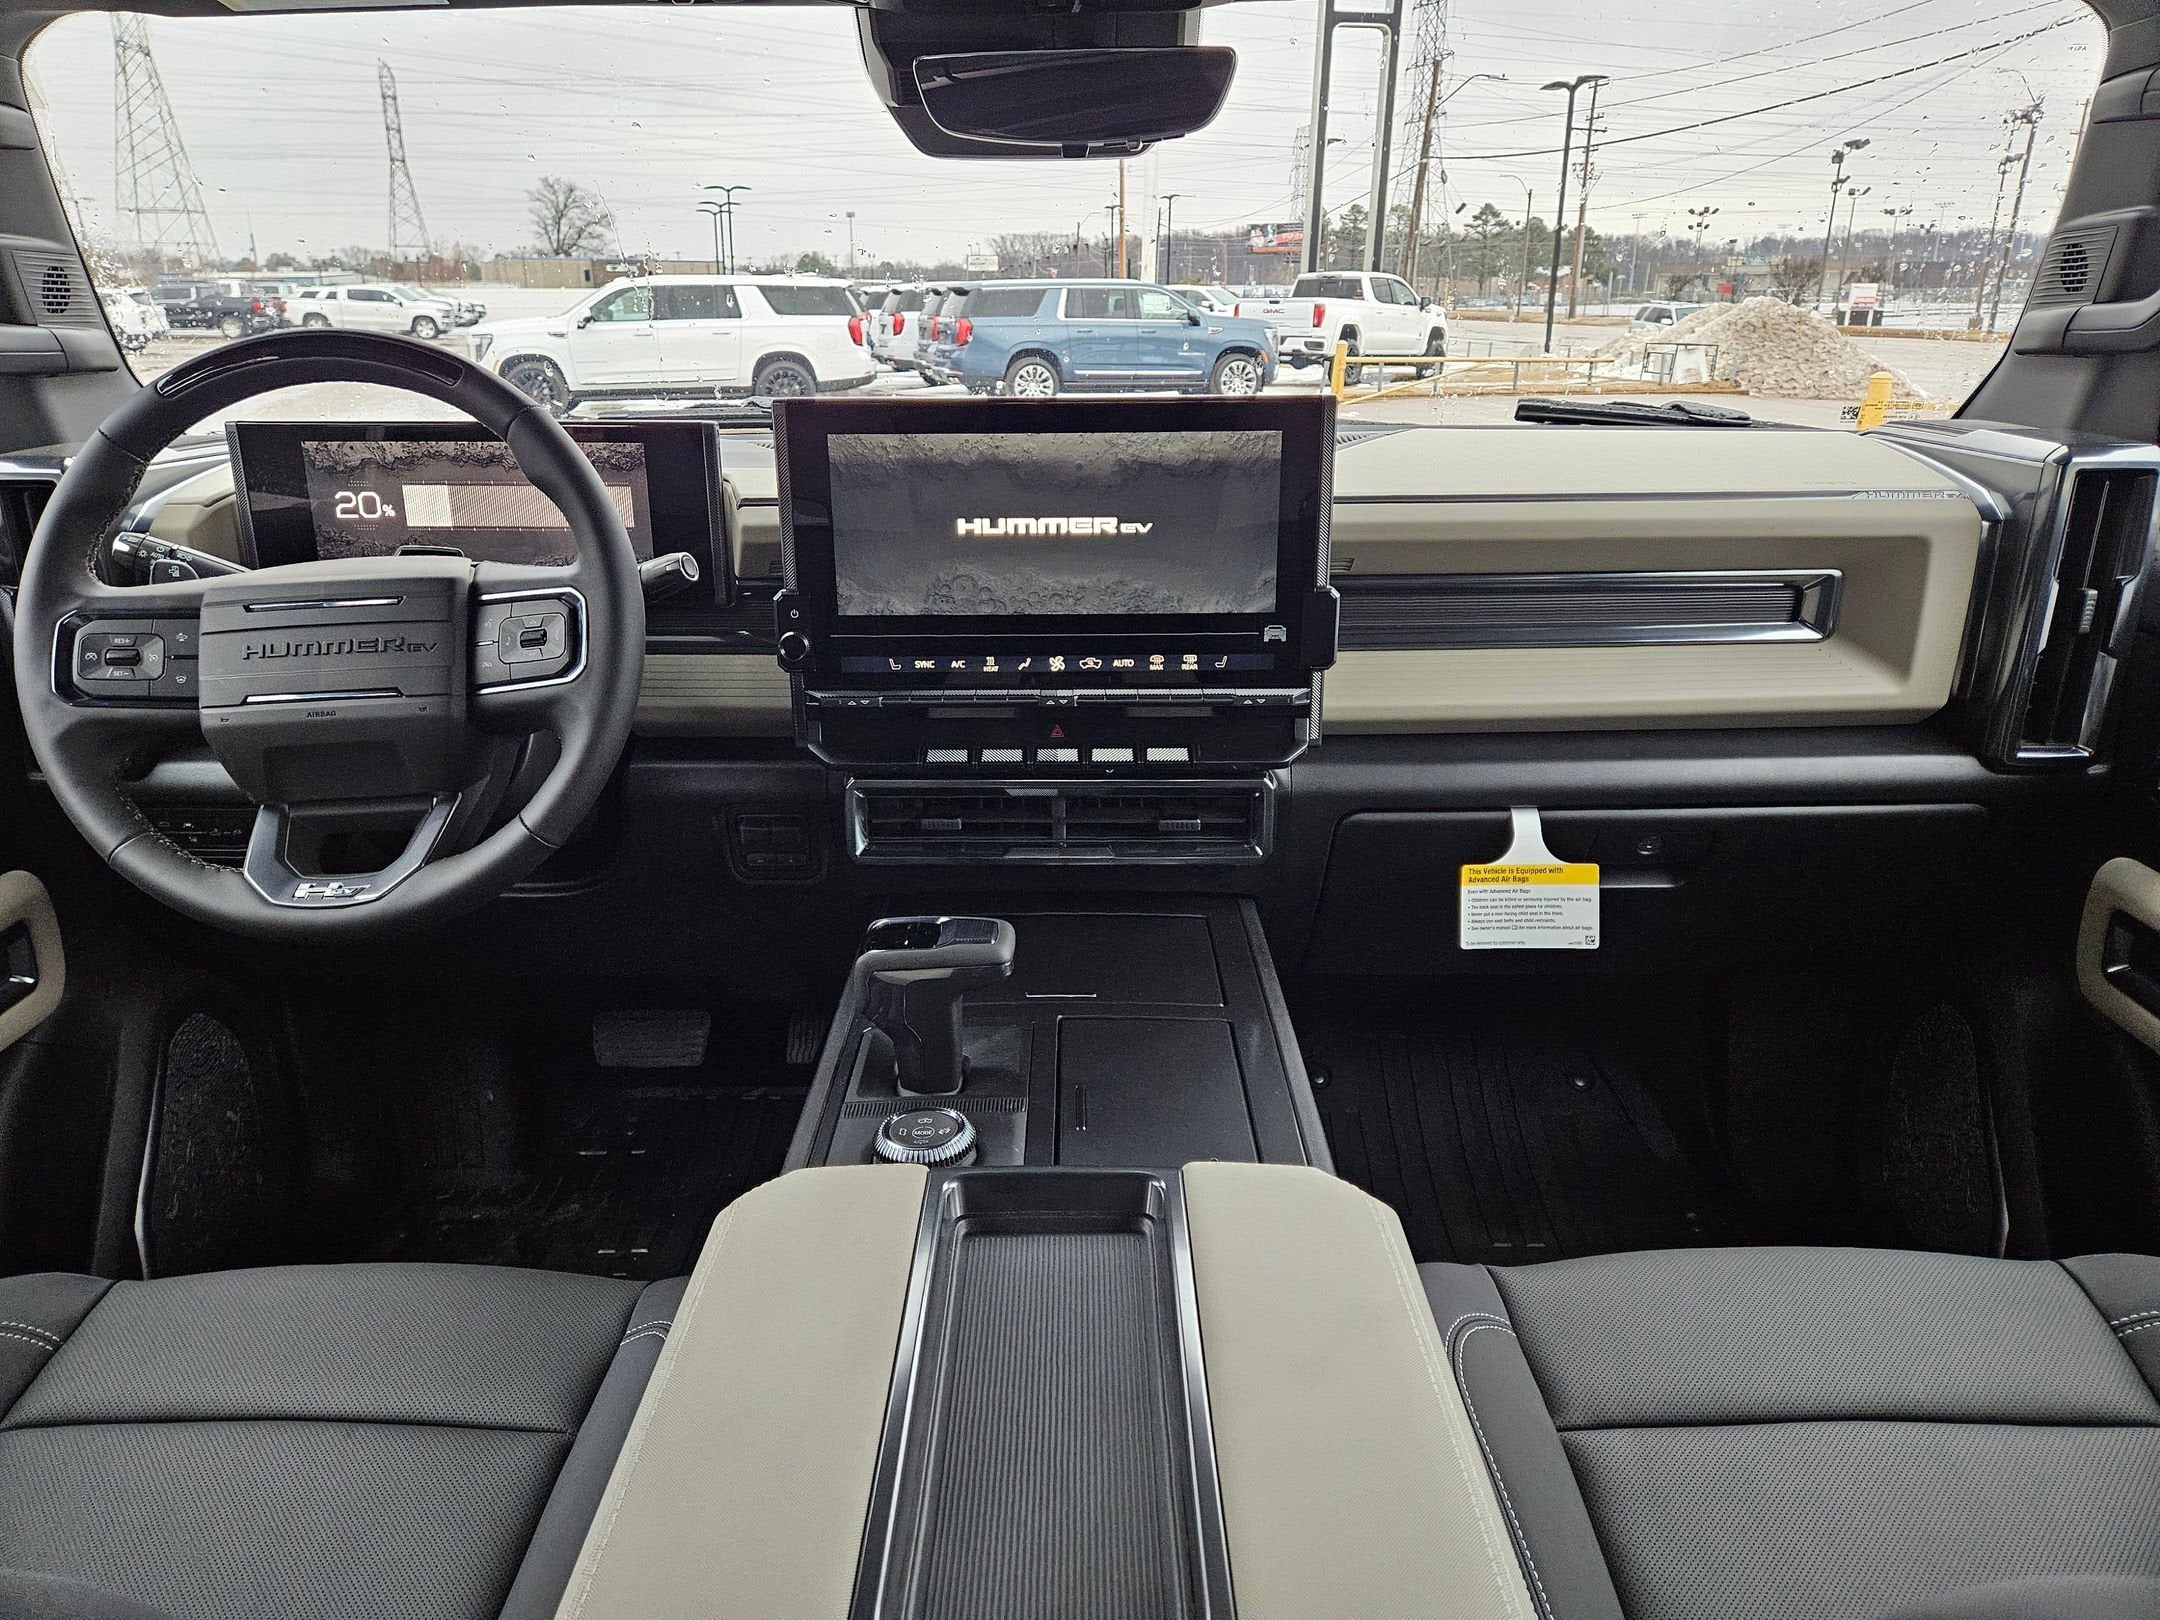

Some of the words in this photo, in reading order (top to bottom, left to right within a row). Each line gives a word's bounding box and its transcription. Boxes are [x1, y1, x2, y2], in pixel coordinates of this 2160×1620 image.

[1865, 490, 1945, 499] HUMMER
[956, 517, 1118, 535] HUMMER
[1120, 522, 1153, 534] EV
[242, 636, 405, 660] HUMMER
[407, 640, 440, 654] EV
[914, 660, 935, 669] SYNC
[951, 660, 966, 668] A/C
[1112, 659, 1135, 668] AUTO
[306, 710, 337, 719] AIRBAG
[1516, 867, 1547, 876] Equipped
[1512, 876, 1529, 884] Bags
